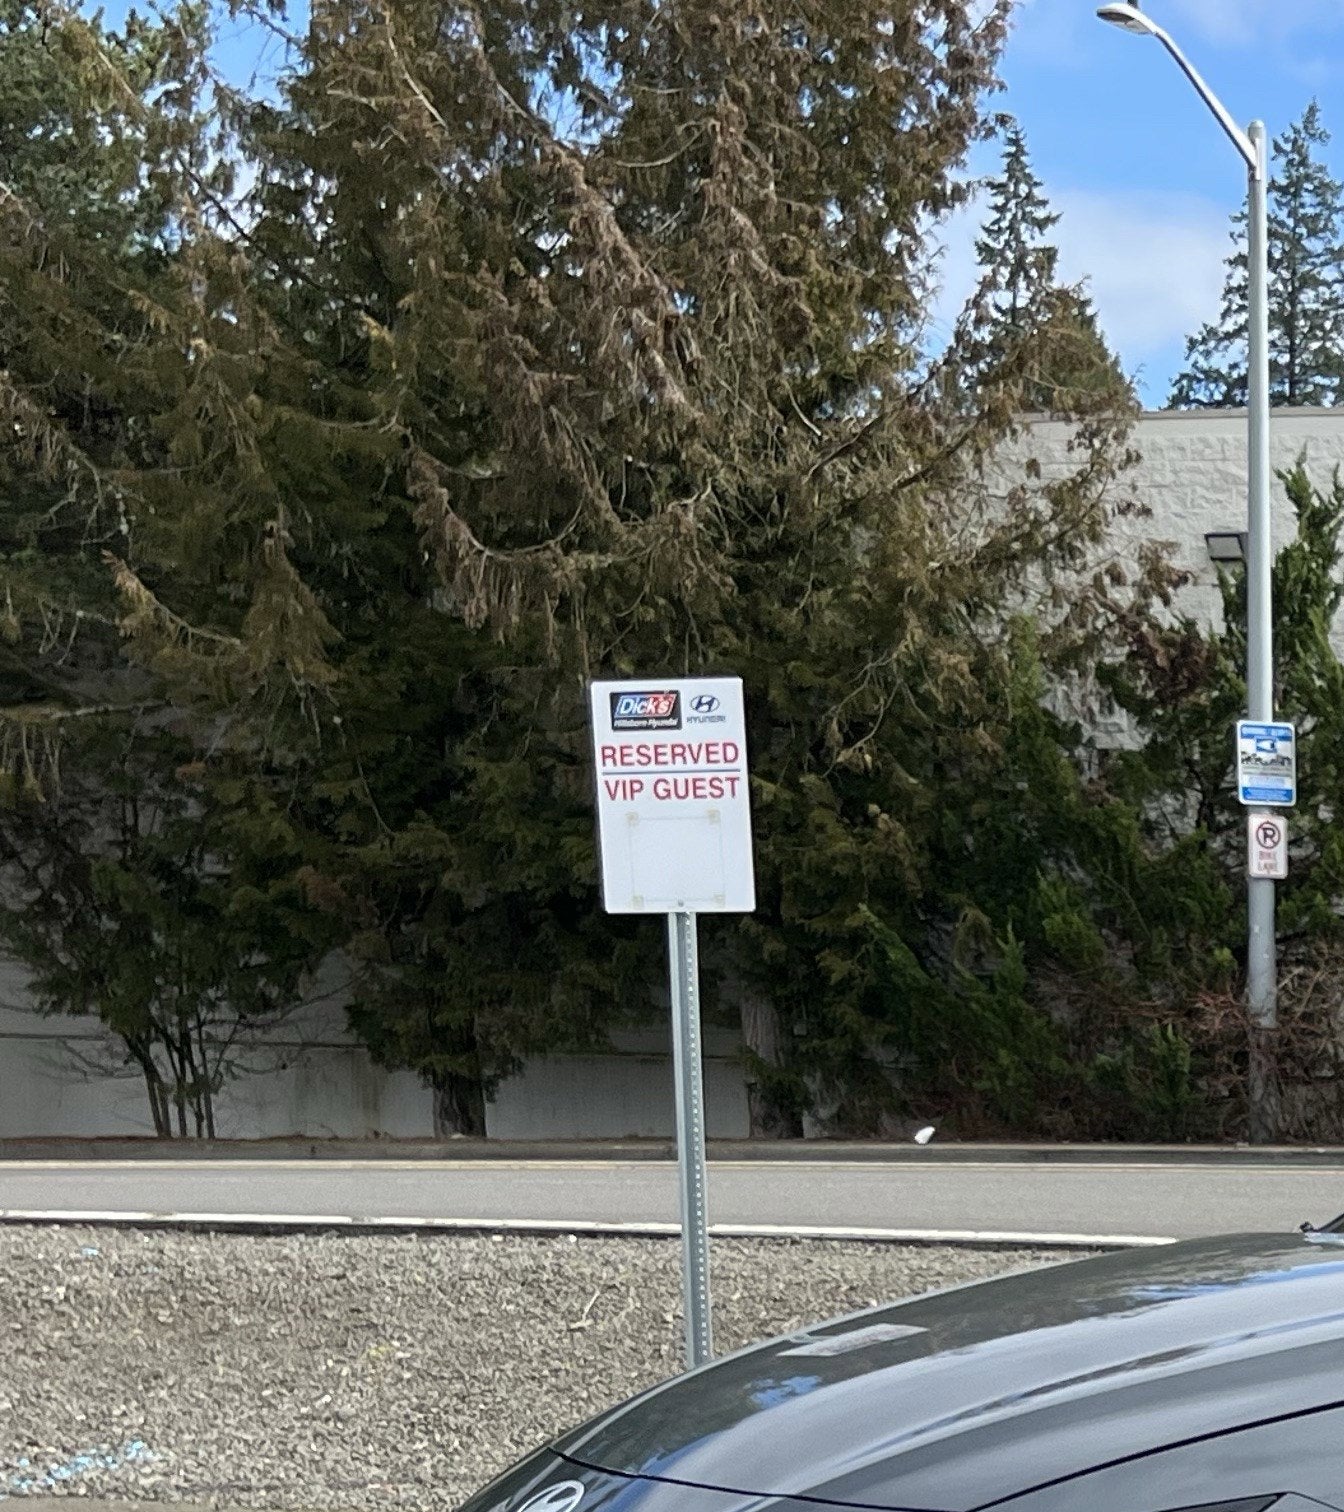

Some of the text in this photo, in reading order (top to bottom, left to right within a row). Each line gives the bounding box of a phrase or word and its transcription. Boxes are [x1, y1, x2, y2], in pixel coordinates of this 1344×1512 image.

[601, 742, 739, 767] RESERVED
[604, 776, 740, 801] VIP GUEST
